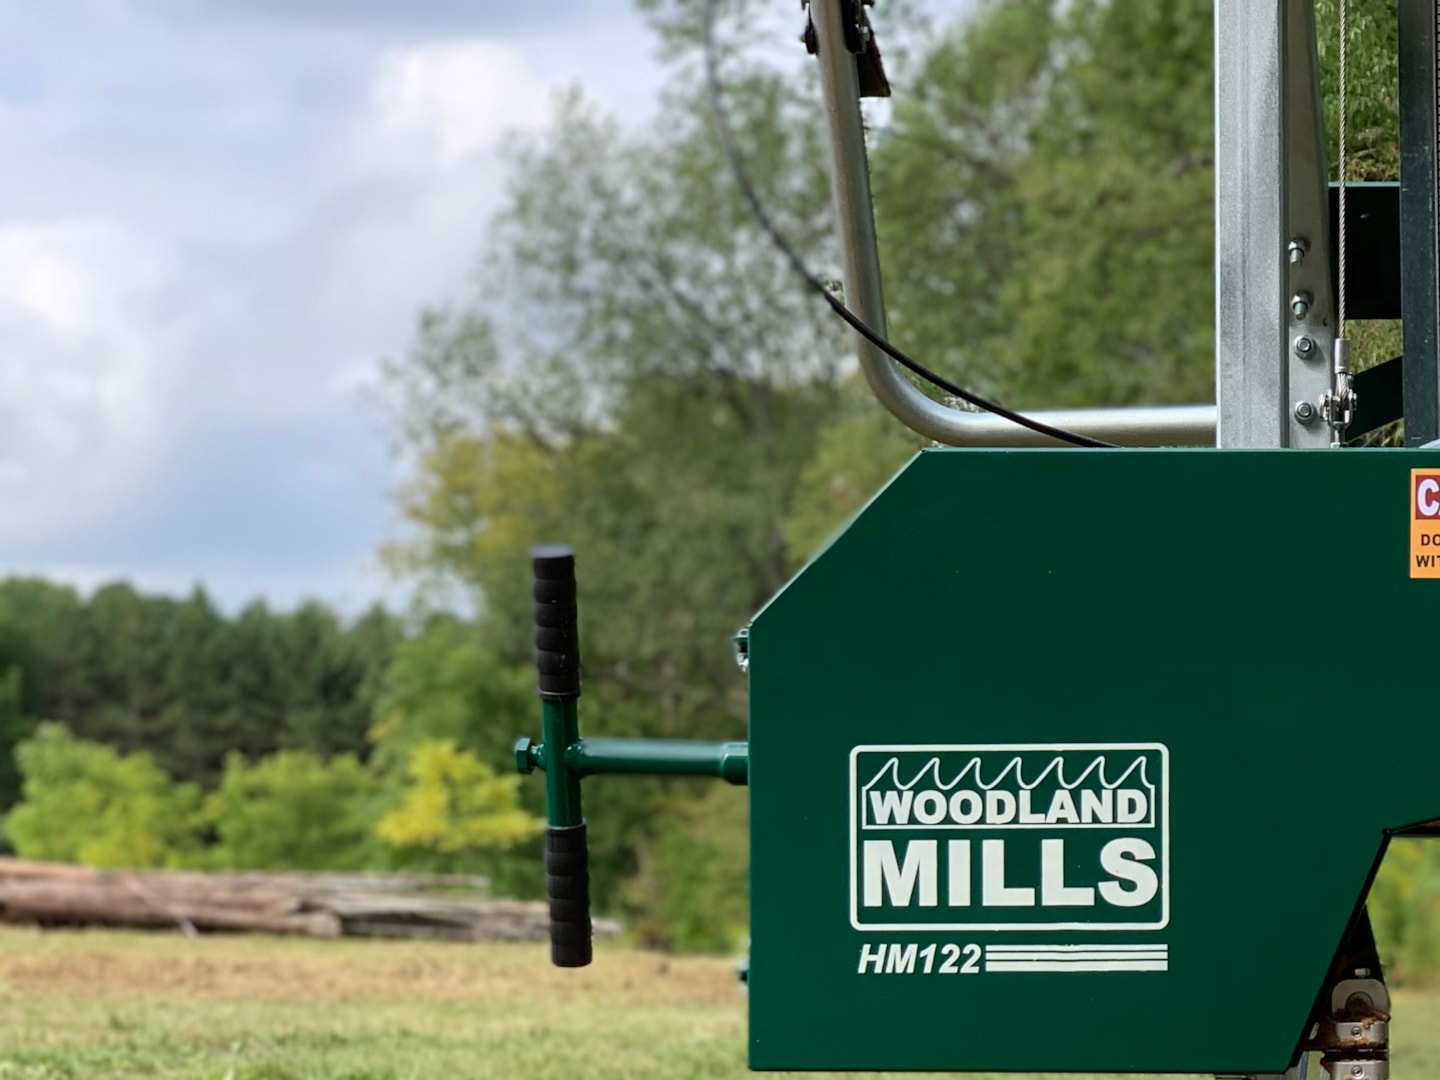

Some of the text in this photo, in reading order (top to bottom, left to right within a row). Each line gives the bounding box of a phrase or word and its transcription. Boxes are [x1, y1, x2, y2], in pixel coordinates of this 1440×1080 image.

[869, 788, 1148, 825] WOODLAND
[863, 837, 1159, 907] MILLS
[857, 943, 982, 974] HM122
